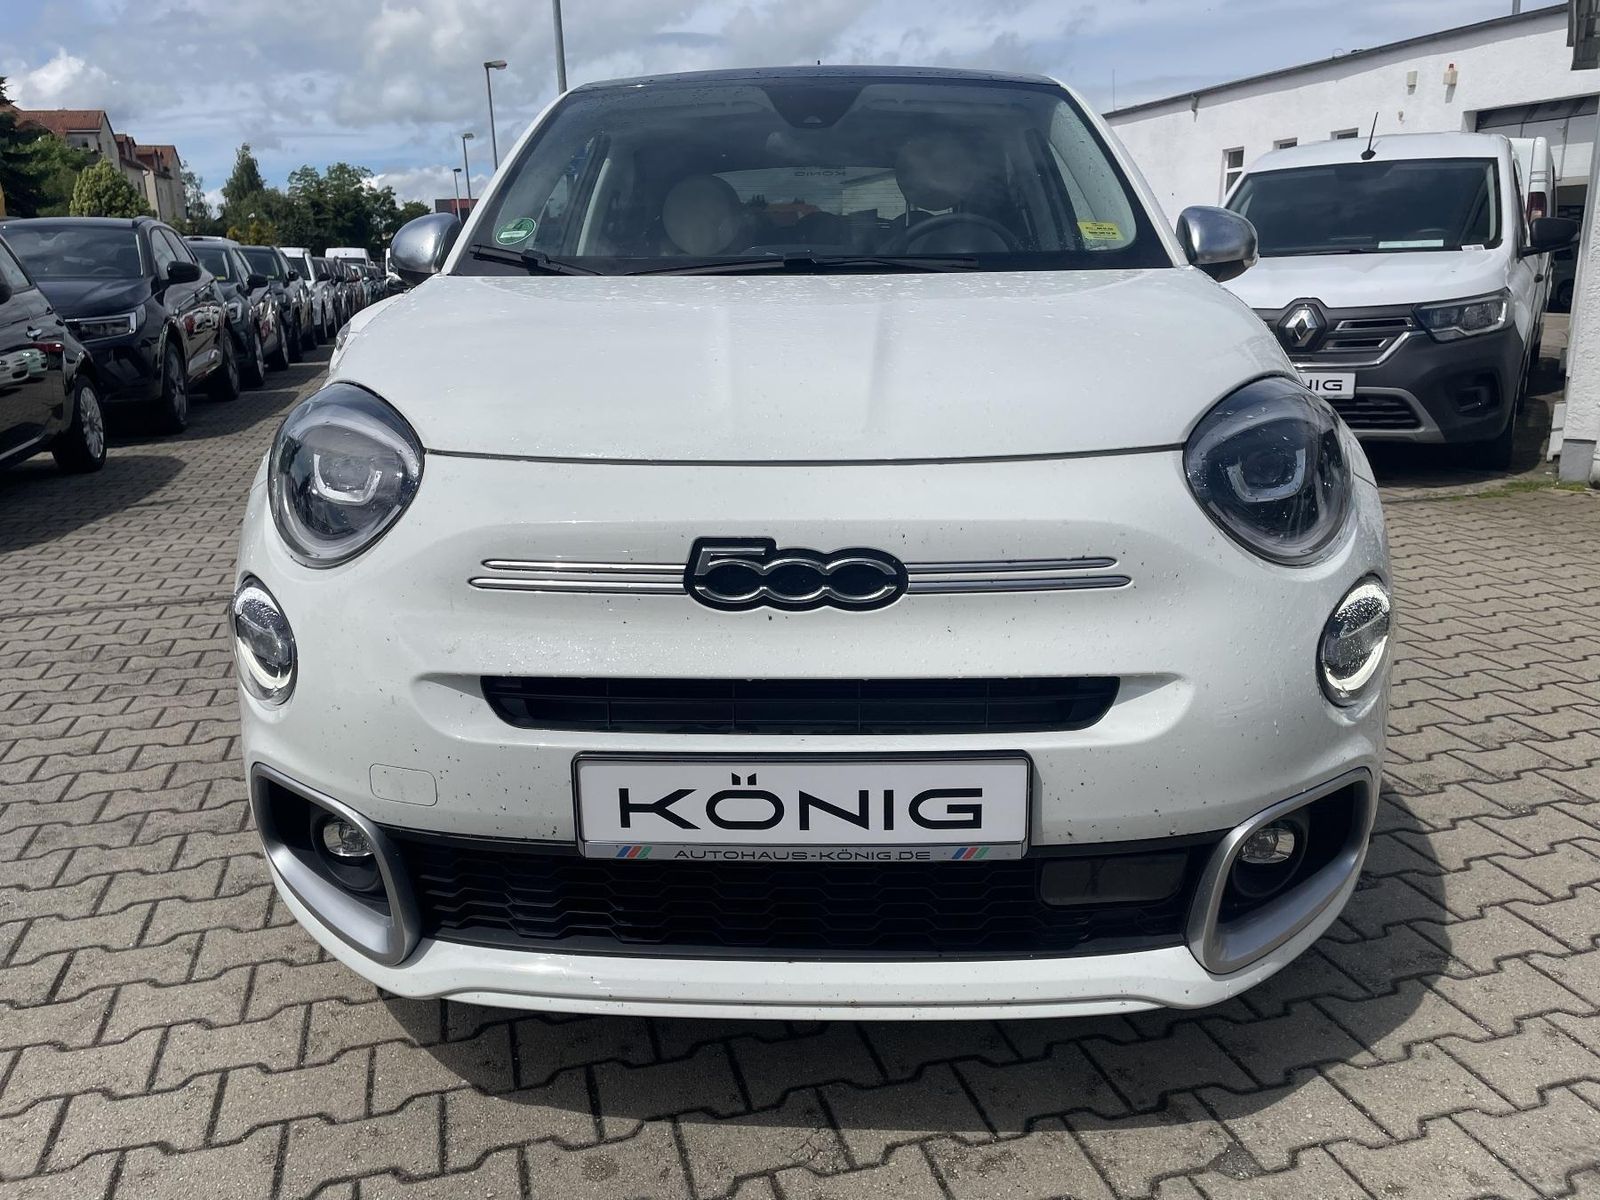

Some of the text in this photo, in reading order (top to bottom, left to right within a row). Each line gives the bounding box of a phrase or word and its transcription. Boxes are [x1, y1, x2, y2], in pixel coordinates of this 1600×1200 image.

[693, 547, 898, 603] 500
[618, 773, 983, 831] KÖNIG
[674, 848, 931, 861] AUTOHAUS-KÖNIG.DE
